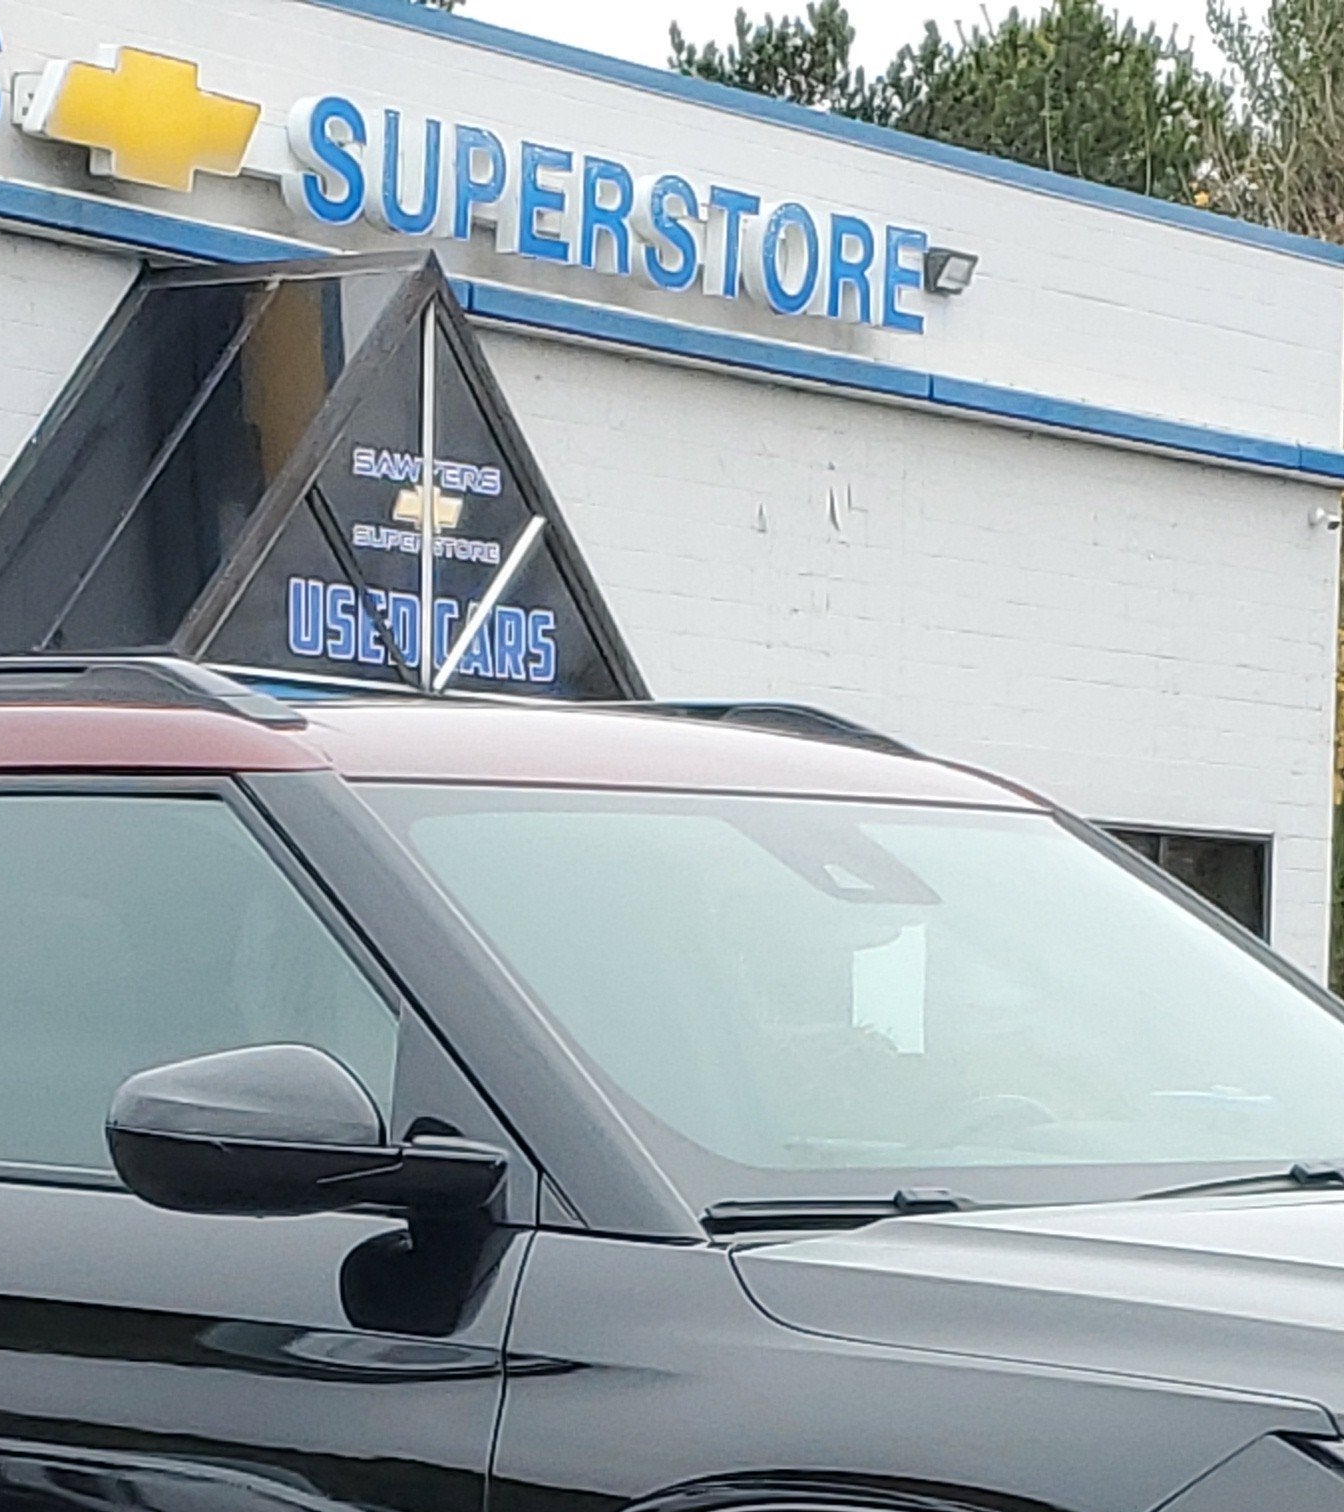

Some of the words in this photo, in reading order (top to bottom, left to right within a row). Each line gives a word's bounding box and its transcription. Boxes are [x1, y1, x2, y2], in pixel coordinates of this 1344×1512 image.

[298, 94, 932, 335] SUPERSTORE
[289, 577, 421, 667] USED
[433, 598, 556, 682] CARS
